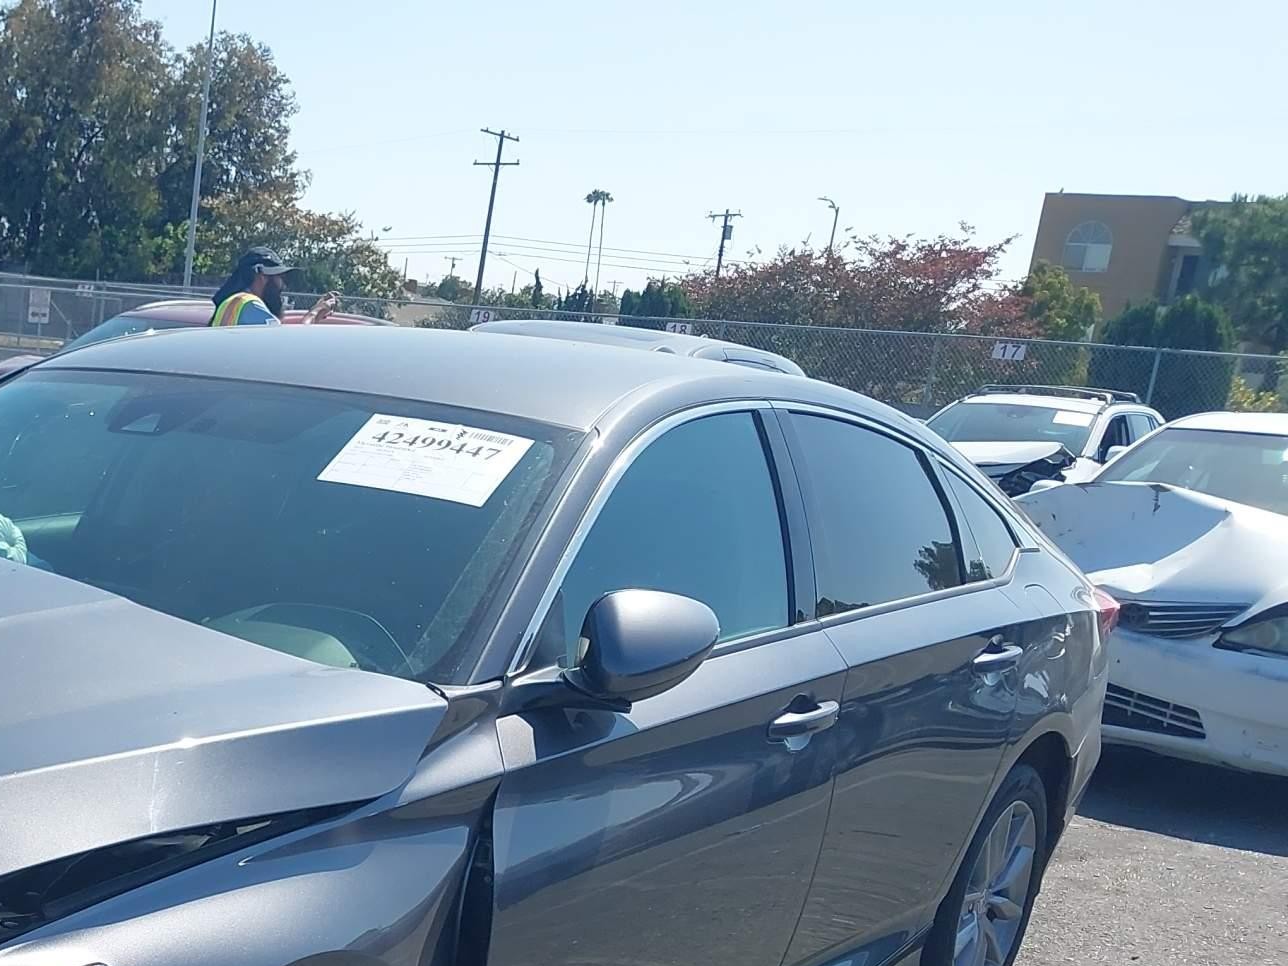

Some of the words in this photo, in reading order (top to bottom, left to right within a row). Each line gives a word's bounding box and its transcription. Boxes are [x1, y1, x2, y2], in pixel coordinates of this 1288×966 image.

[474, 310, 490, 322] 19
[670, 324, 687, 334] 18
[1000, 344, 1021, 358] 17
[372, 430, 503, 460] 42499447
